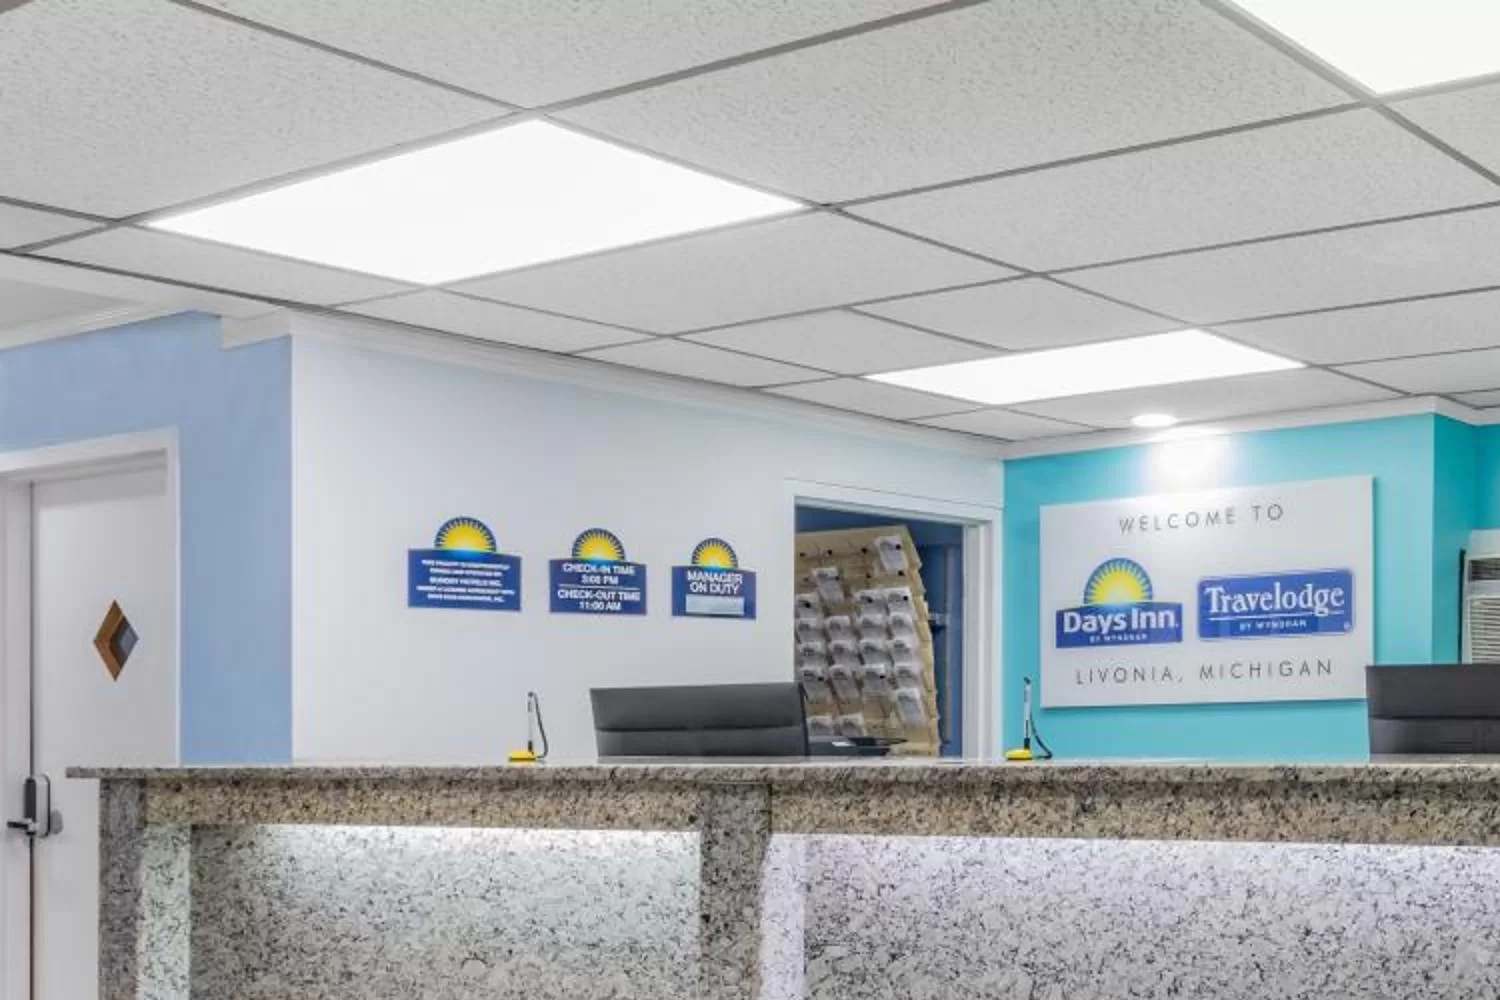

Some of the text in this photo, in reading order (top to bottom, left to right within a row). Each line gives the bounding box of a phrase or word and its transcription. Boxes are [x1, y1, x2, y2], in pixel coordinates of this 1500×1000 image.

[1119, 503, 1284, 534] WELCOME TO
[562, 563, 636, 576] CHECK-IN TIME
[603, 575, 619, 585] PM
[687, 570, 743, 584] MANAGER
[689, 581, 739, 594] ON DUTY
[557, 589, 640, 601] CHECK-OUT TIME
[1203, 581, 1345, 617] Travelodge
[579, 601, 621, 610] 11:00 AM
[1063, 607, 1175, 635] Days Inn
[1075, 659, 1333, 686] LIVONIA, MICHIGAN
